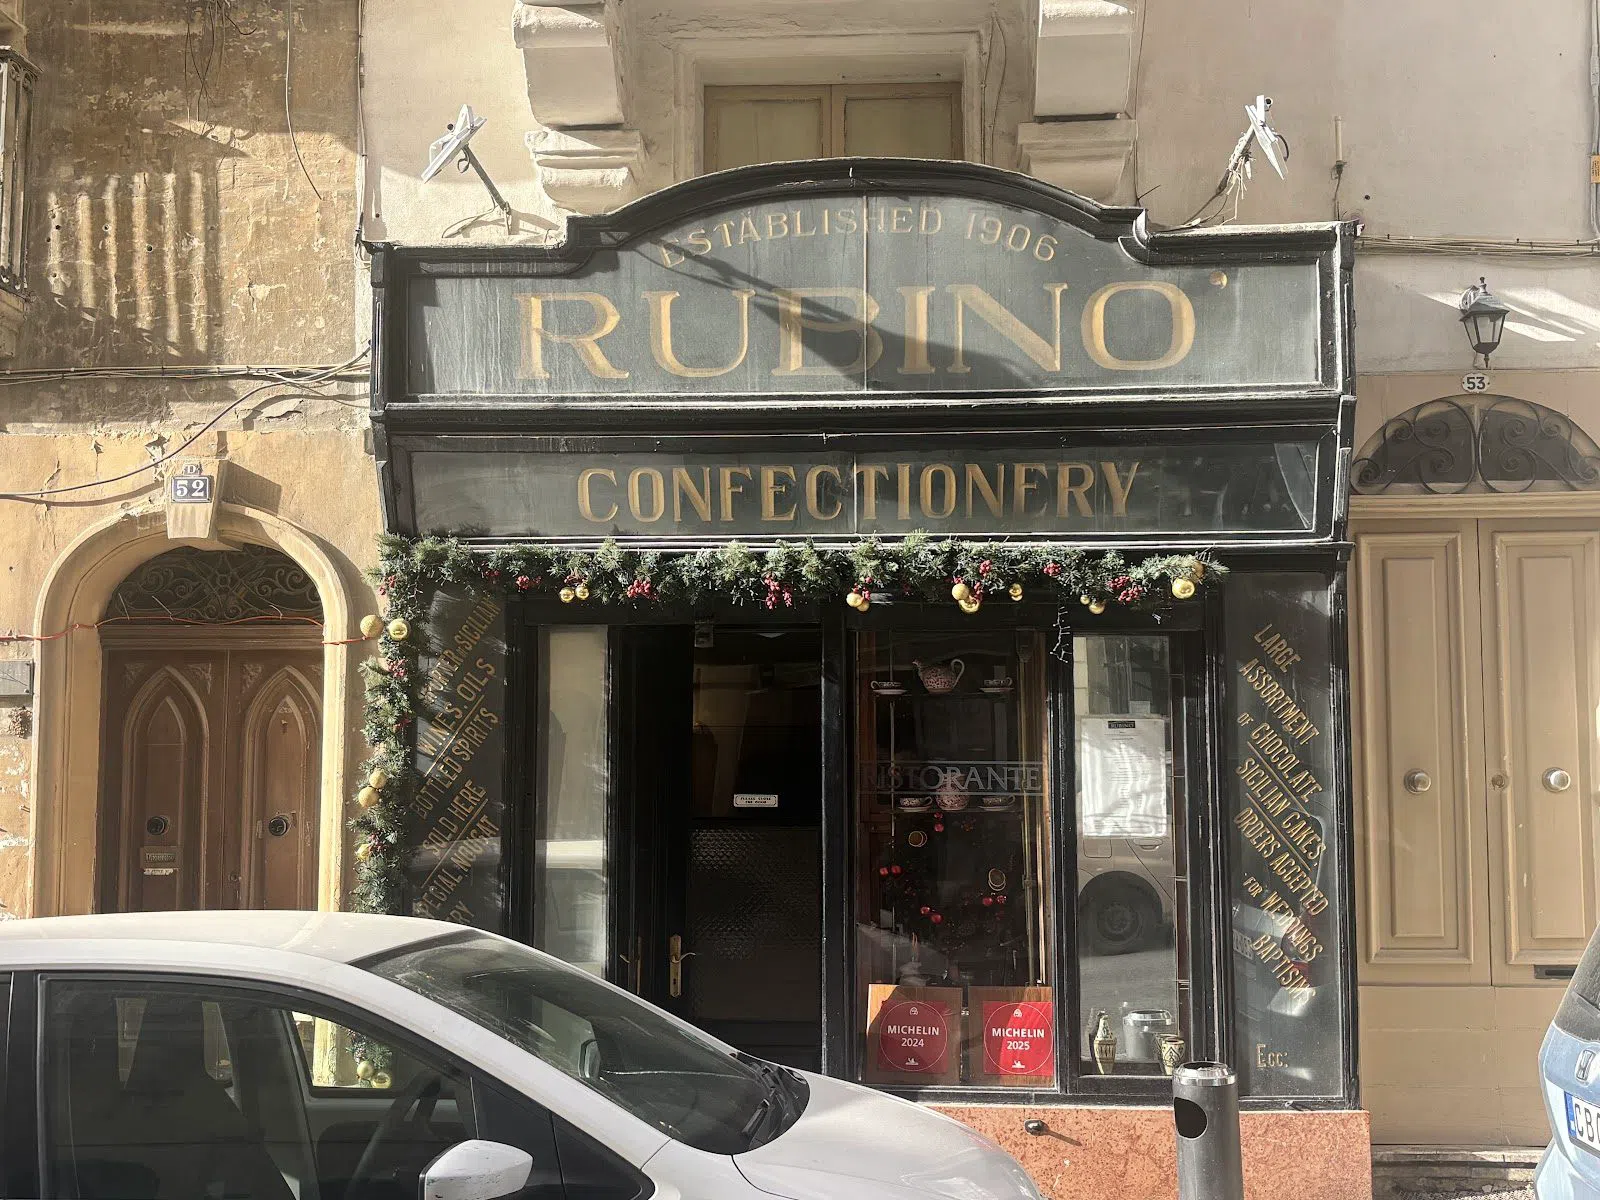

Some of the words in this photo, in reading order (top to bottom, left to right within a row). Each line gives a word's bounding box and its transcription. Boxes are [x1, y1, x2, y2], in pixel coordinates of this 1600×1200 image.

[656, 207, 942, 268] ESTABLISHED
[965, 213, 1058, 261] 1906
[514, 280, 1196, 380] RUBINO
[1466, 377, 1486, 390] 53
[176, 480, 205, 497] 52
[577, 462, 1140, 524] CONFECTIONERY
[454, 597, 501, 651] SICILIAN
[1253, 623, 1301, 673] LARGE
[457, 658, 496, 701] OILS
[1239, 657, 1320, 746] ASSORTMENT
[409, 756, 463, 820] BOTTLED
[452, 707, 498, 761] SPIRITS
[1235, 757, 1291, 818] SICILIAN
[1237, 712, 1254, 728] OF
[1250, 722, 1323, 803] CHOCOLATE
[423, 816, 459, 856] SOLD
[447, 779, 487, 821] HERE
[416, 868, 463, 919] PECIAL
[450, 814, 500, 872] NOUGAT
[1234, 807, 1281, 858] ORDERS
[1270, 851, 1329, 916] ACCEPTED
[1260, 891, 1323, 962] WEDDINGS
[887, 1025, 940, 1036] MICHELIN
[901, 1037, 925, 1047] 2024
[992, 1027, 1045, 1038] MICHELIN
[1007, 1040, 1030, 1050] 2025
